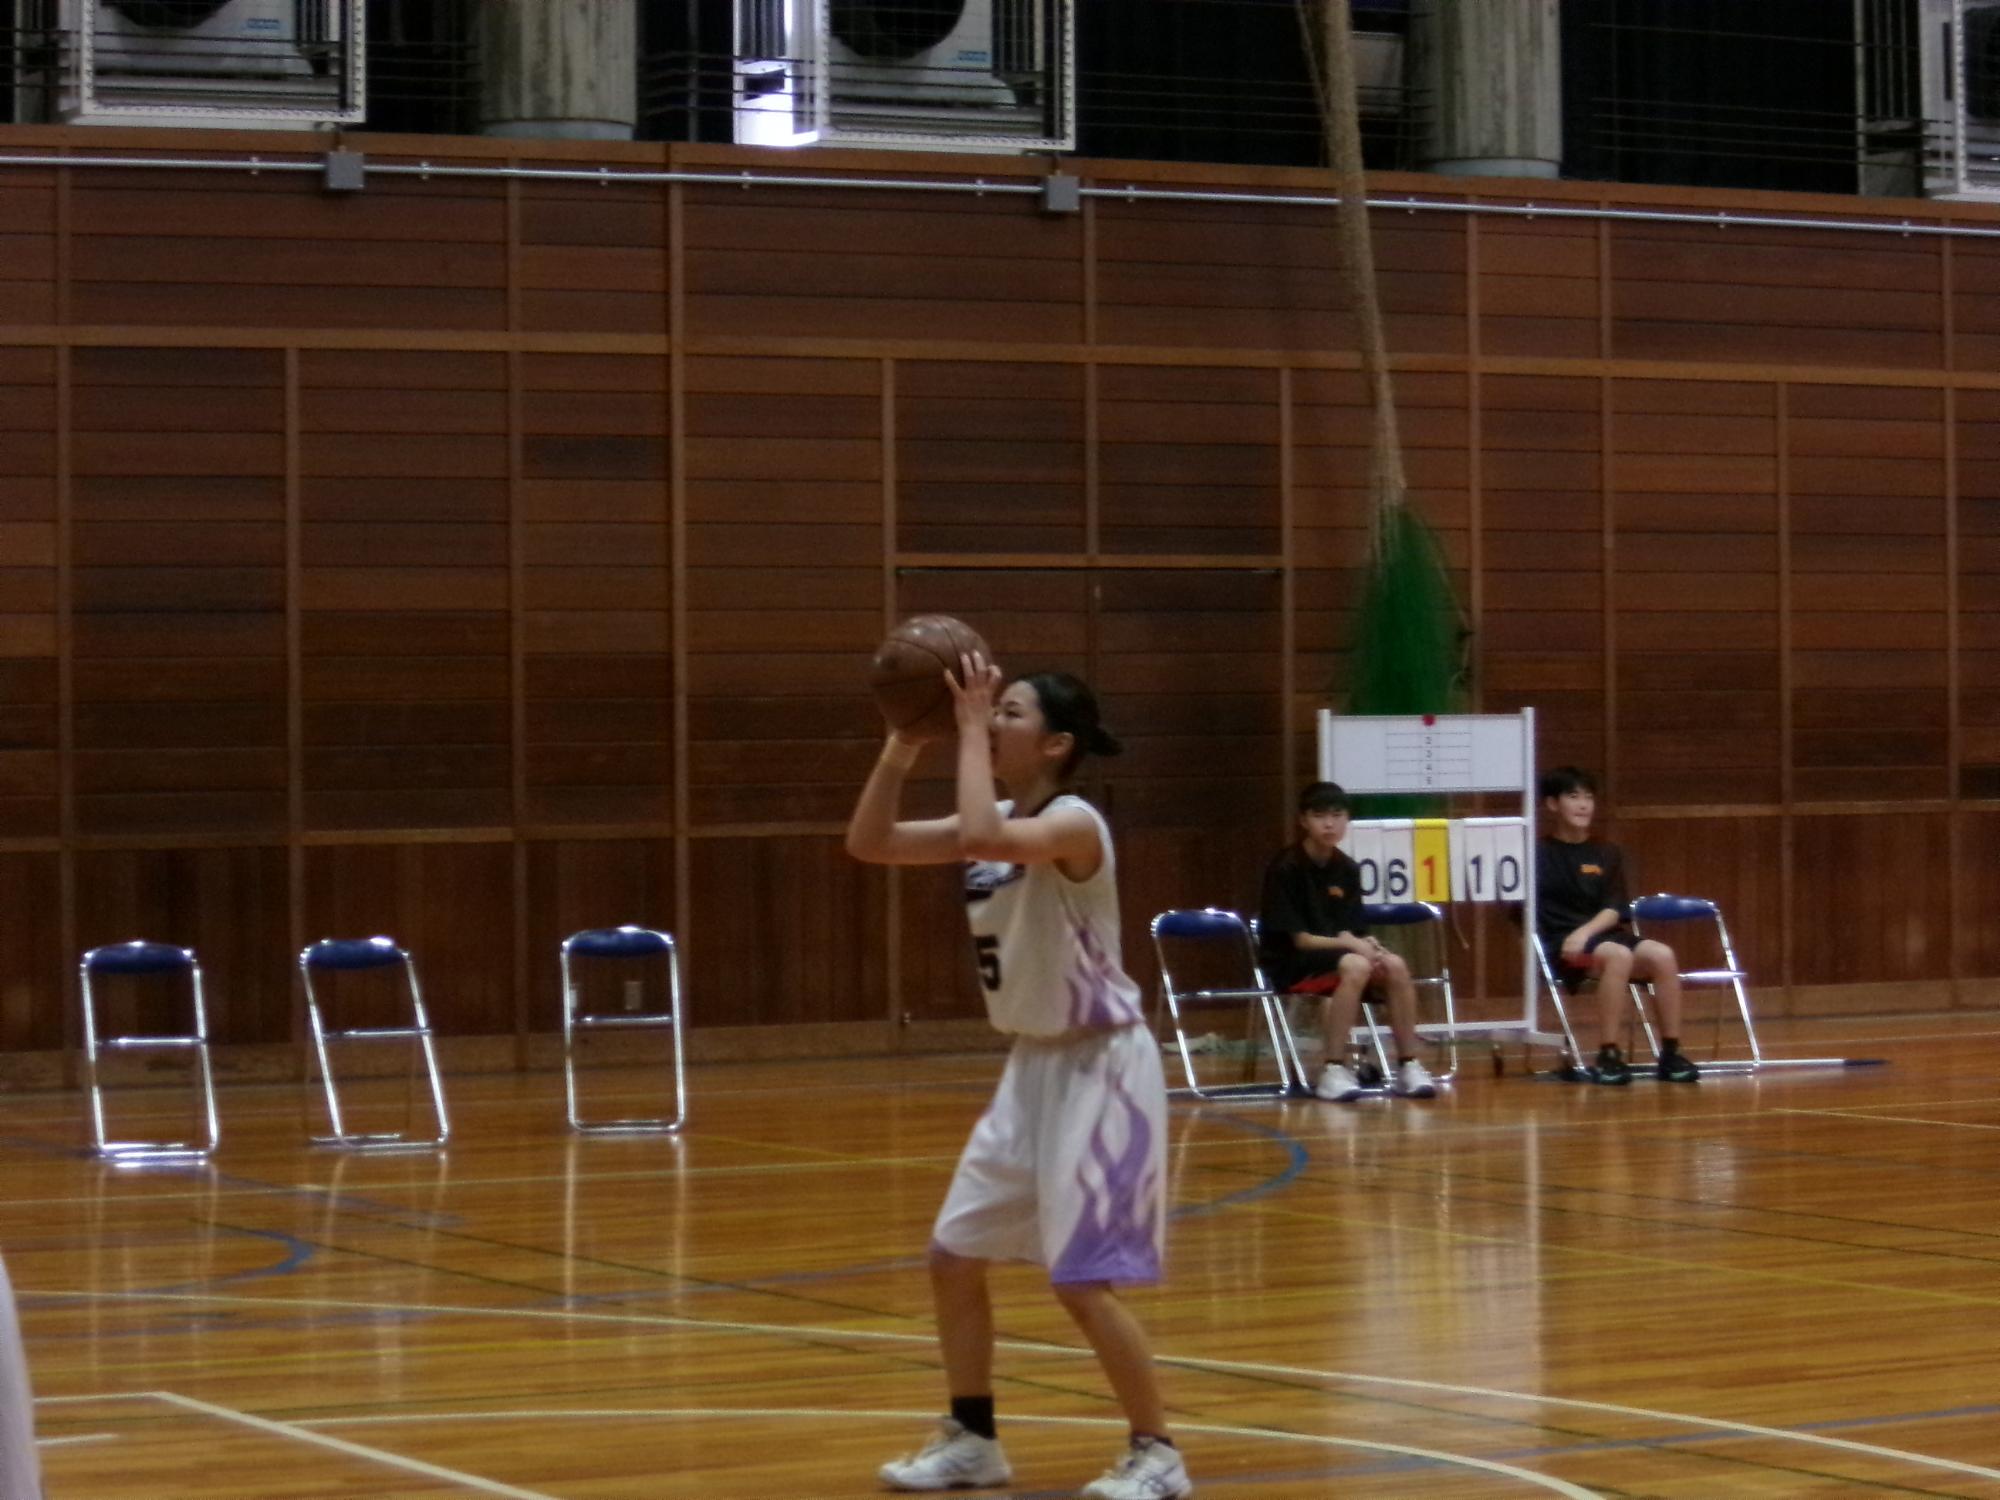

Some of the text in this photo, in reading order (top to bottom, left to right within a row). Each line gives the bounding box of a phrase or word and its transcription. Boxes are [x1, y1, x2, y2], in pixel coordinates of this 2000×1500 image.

[1359, 854, 1520, 897] 06 1 10
